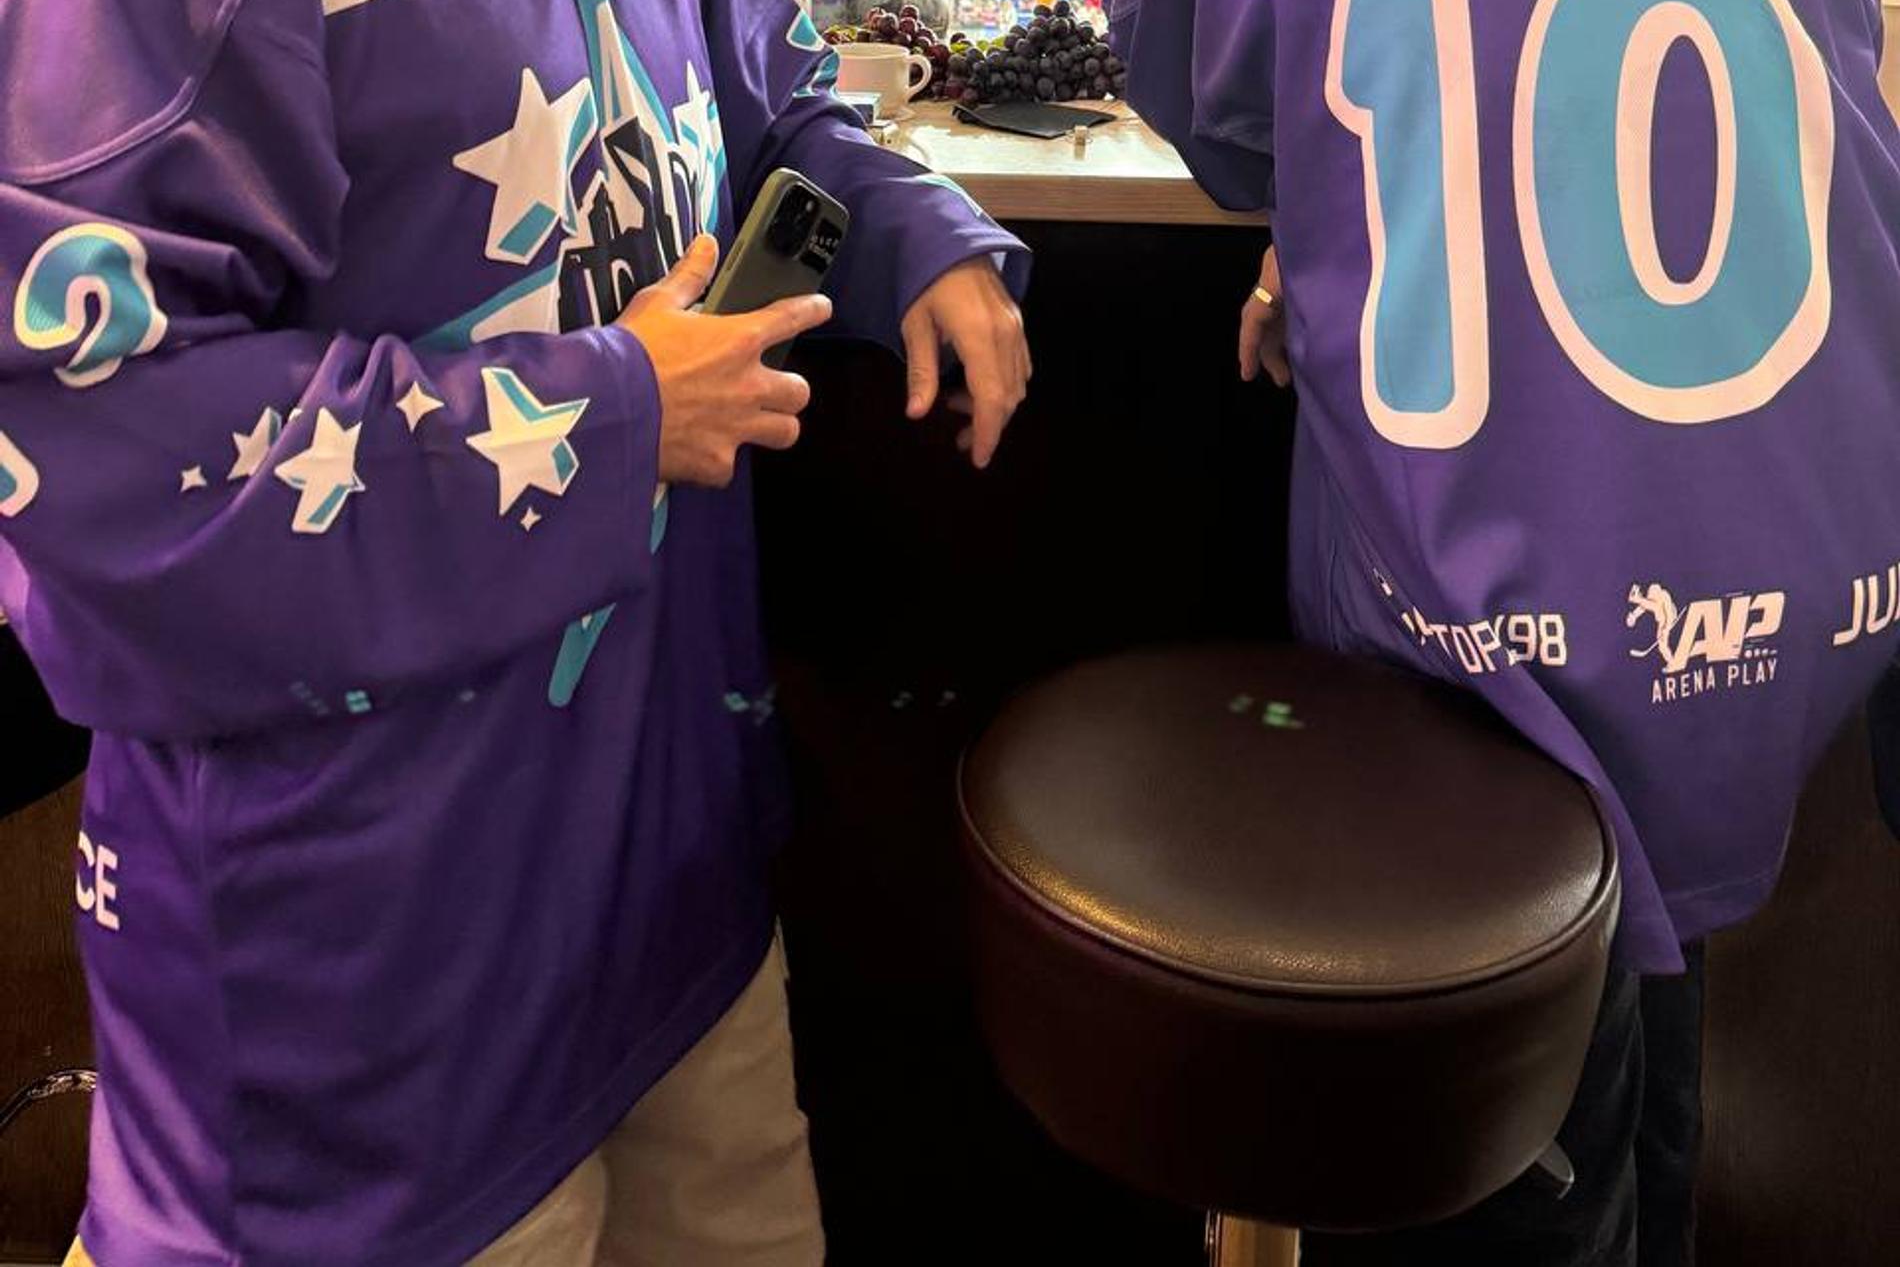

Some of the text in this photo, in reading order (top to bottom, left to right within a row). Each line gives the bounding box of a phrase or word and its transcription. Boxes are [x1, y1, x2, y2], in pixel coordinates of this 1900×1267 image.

[1832, 562, 1900, 647] JU
[1651, 658, 1778, 705] ARENA PLAY
